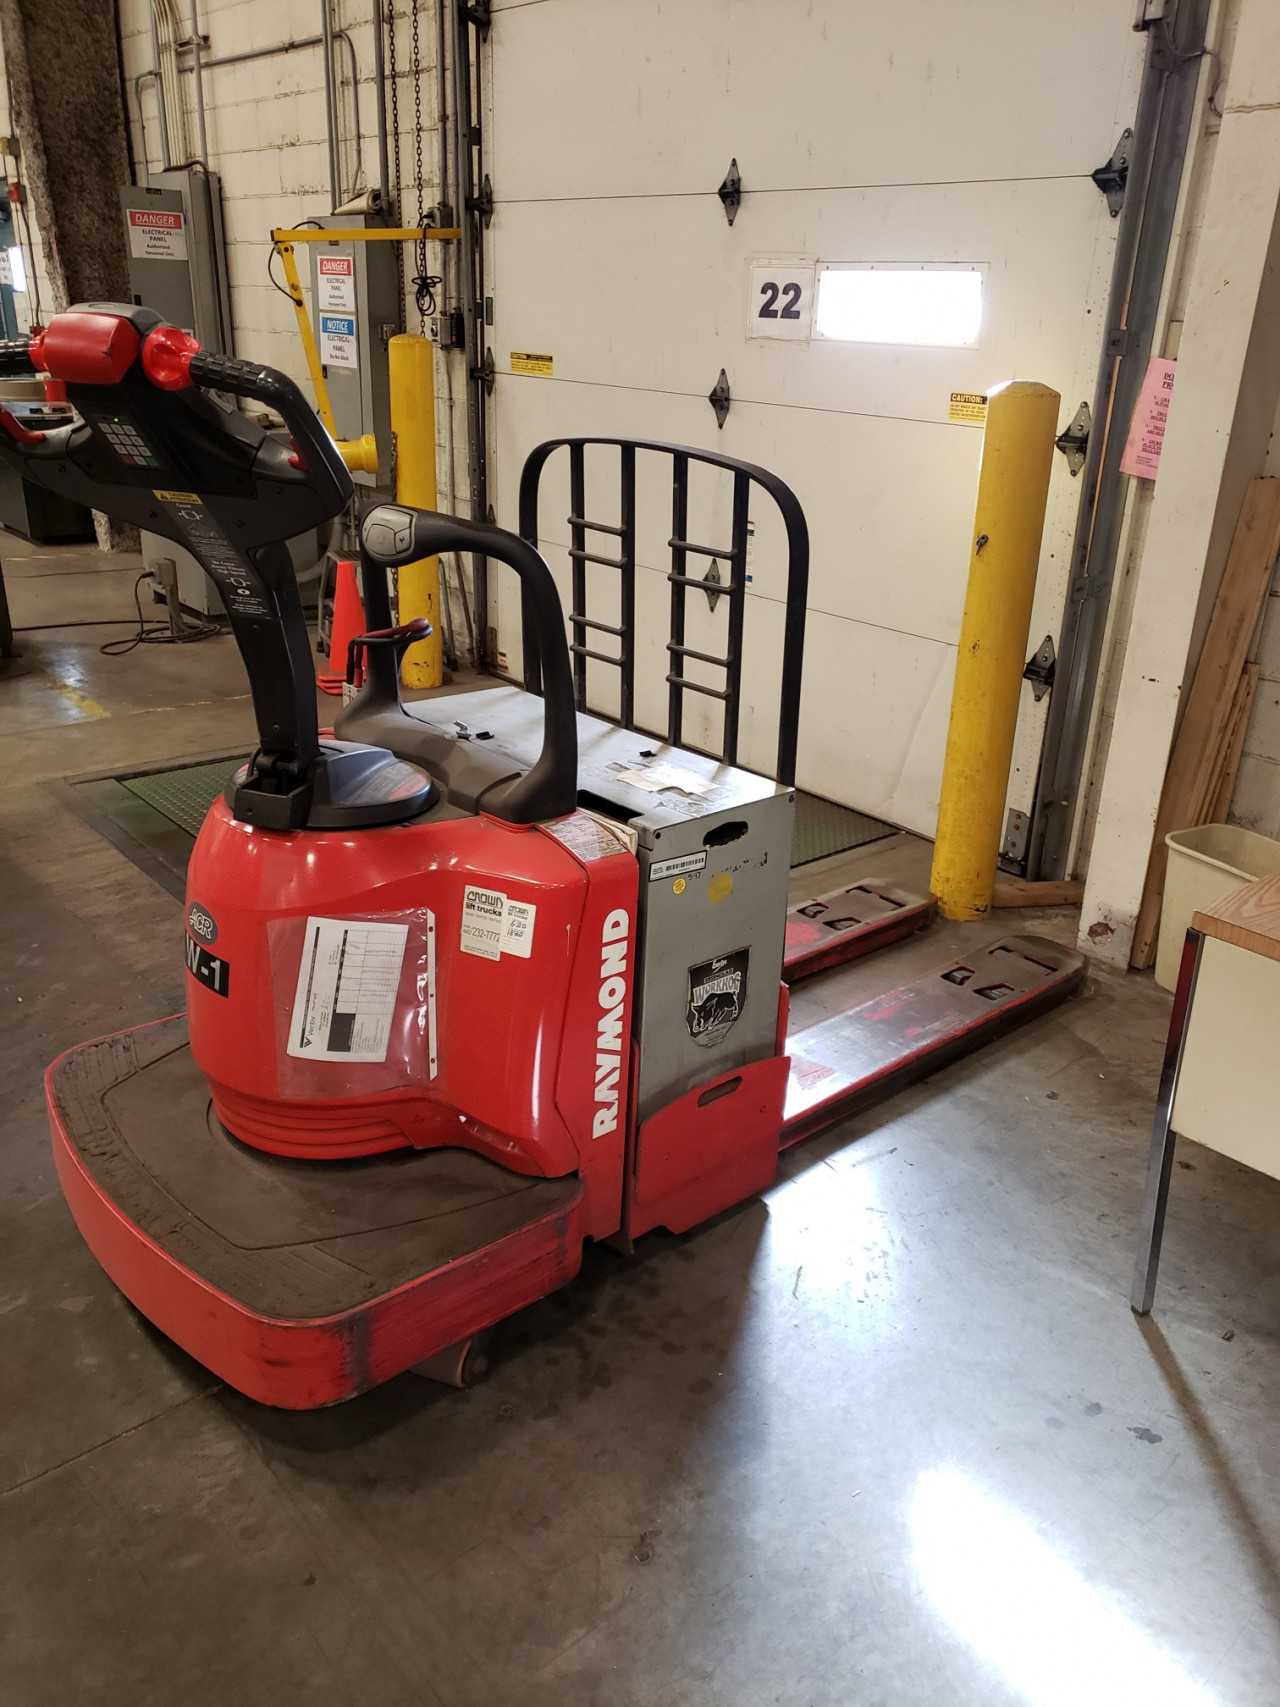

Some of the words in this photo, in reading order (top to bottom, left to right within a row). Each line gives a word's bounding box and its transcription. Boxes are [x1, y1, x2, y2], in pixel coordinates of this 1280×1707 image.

[135, 213, 175, 226] DANGER
[142, 228, 173, 236] ELECTRICAL
[321, 259, 348, 272] DANGER
[758, 282, 802, 320] 22
[327, 319, 349, 331] NOTICE
[467, 890, 504, 909] CROWN
[465, 901, 476, 911] lift
[477, 905, 502, 917] trucks
[592, 908, 630, 1140] RAYMOND
